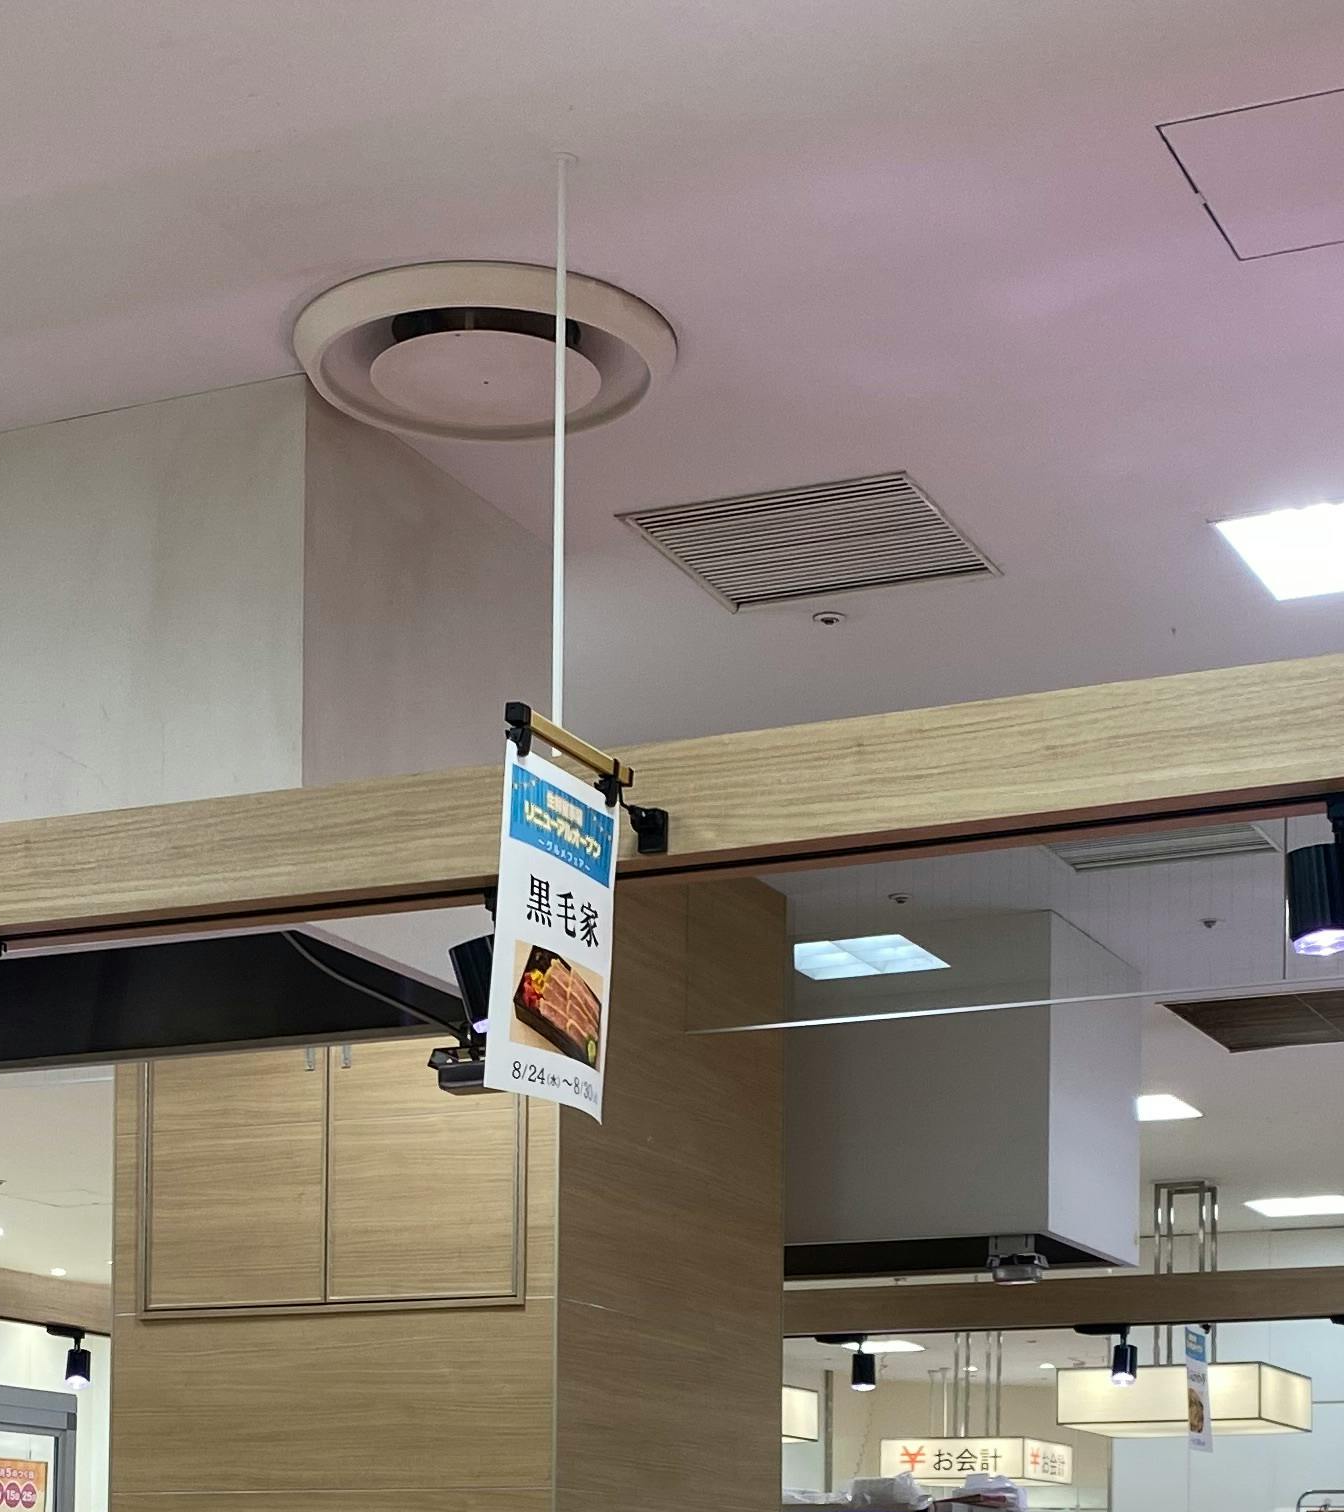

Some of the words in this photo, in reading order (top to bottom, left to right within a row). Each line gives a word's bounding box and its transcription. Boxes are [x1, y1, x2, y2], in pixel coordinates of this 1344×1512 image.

[526, 873, 600, 949] 黒毛家
[933, 1448, 1002, 1472] お会計
